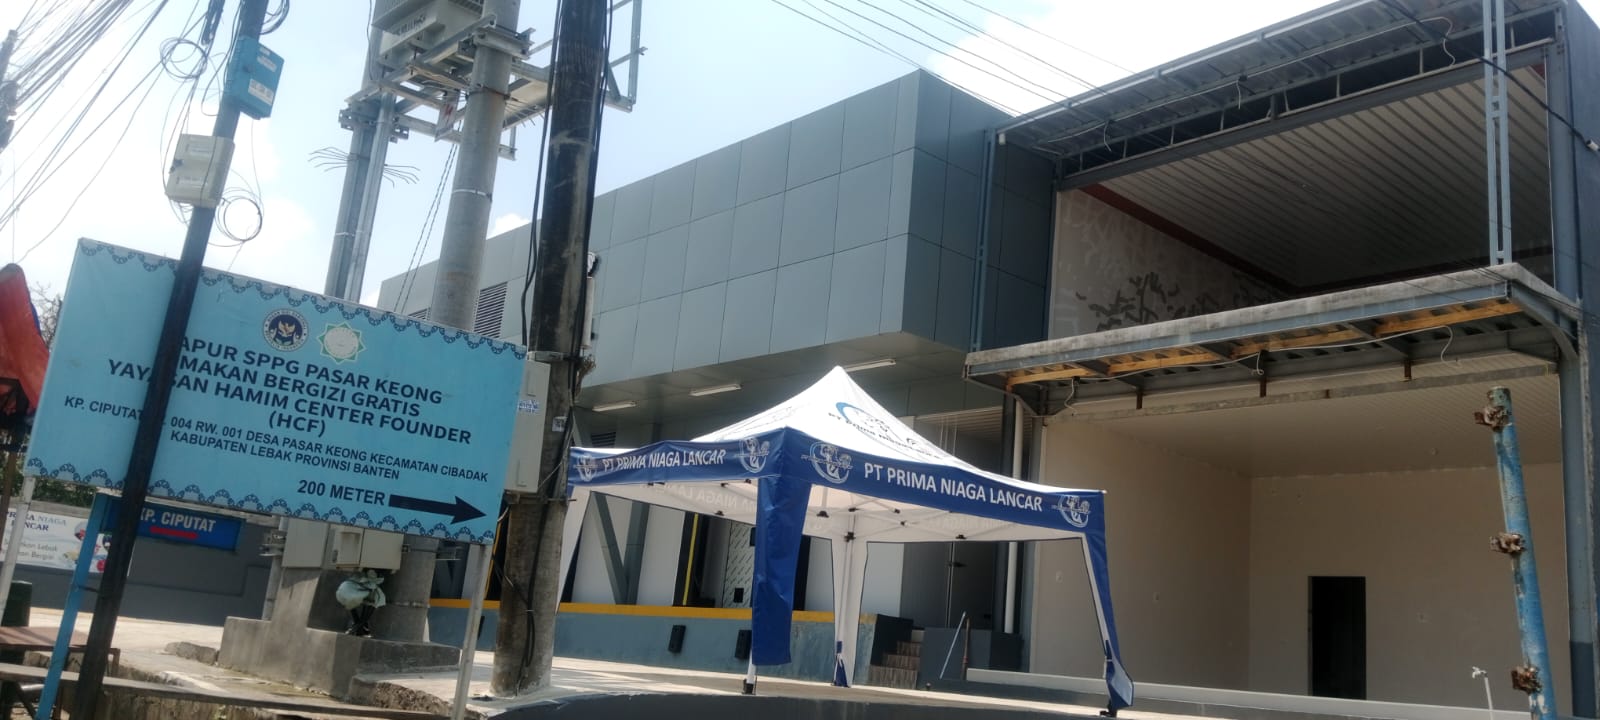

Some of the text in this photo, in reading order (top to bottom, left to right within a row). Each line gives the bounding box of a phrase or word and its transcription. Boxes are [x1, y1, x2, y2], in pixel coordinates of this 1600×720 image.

[179, 356, 420, 416] MAKAN BERGIZI GRATIS
[180, 337, 442, 404] APUR SPPG PASAR KEONG
[108, 359, 471, 444] YAYAN HAMIM CENTER FOUNDER
[269, 411, 325, 438] (HCF)
[64, 396, 85, 410] KP.
[170, 416, 192, 429] 004
[195, 421, 218, 435] RW.
[222, 426, 242, 439] 001
[246, 430, 279, 446] DESA
[282, 437, 322, 453] PASAR
[325, 445, 367, 461] KEONG
[370, 453, 438, 474] KECAMATAN
[441, 465, 488, 482] CIBADAK
[170, 430, 400, 480] KABUPATEN LEBAK PROVINSI BANTEN
[602, 458, 615, 472] PT
[616, 455, 646, 471] PRIMA
[648, 451, 680, 468] NIAGA
[682, 449, 727, 466] LANCAR
[297, 480, 385, 505] 200 METER
[864, 462, 884, 481] PT
[887, 467, 937, 493] PRIMA
[940, 477, 986, 502] NIAGA
[989, 487, 1043, 512] LANCAR
[161, 512, 216, 533] CIPUTAT
